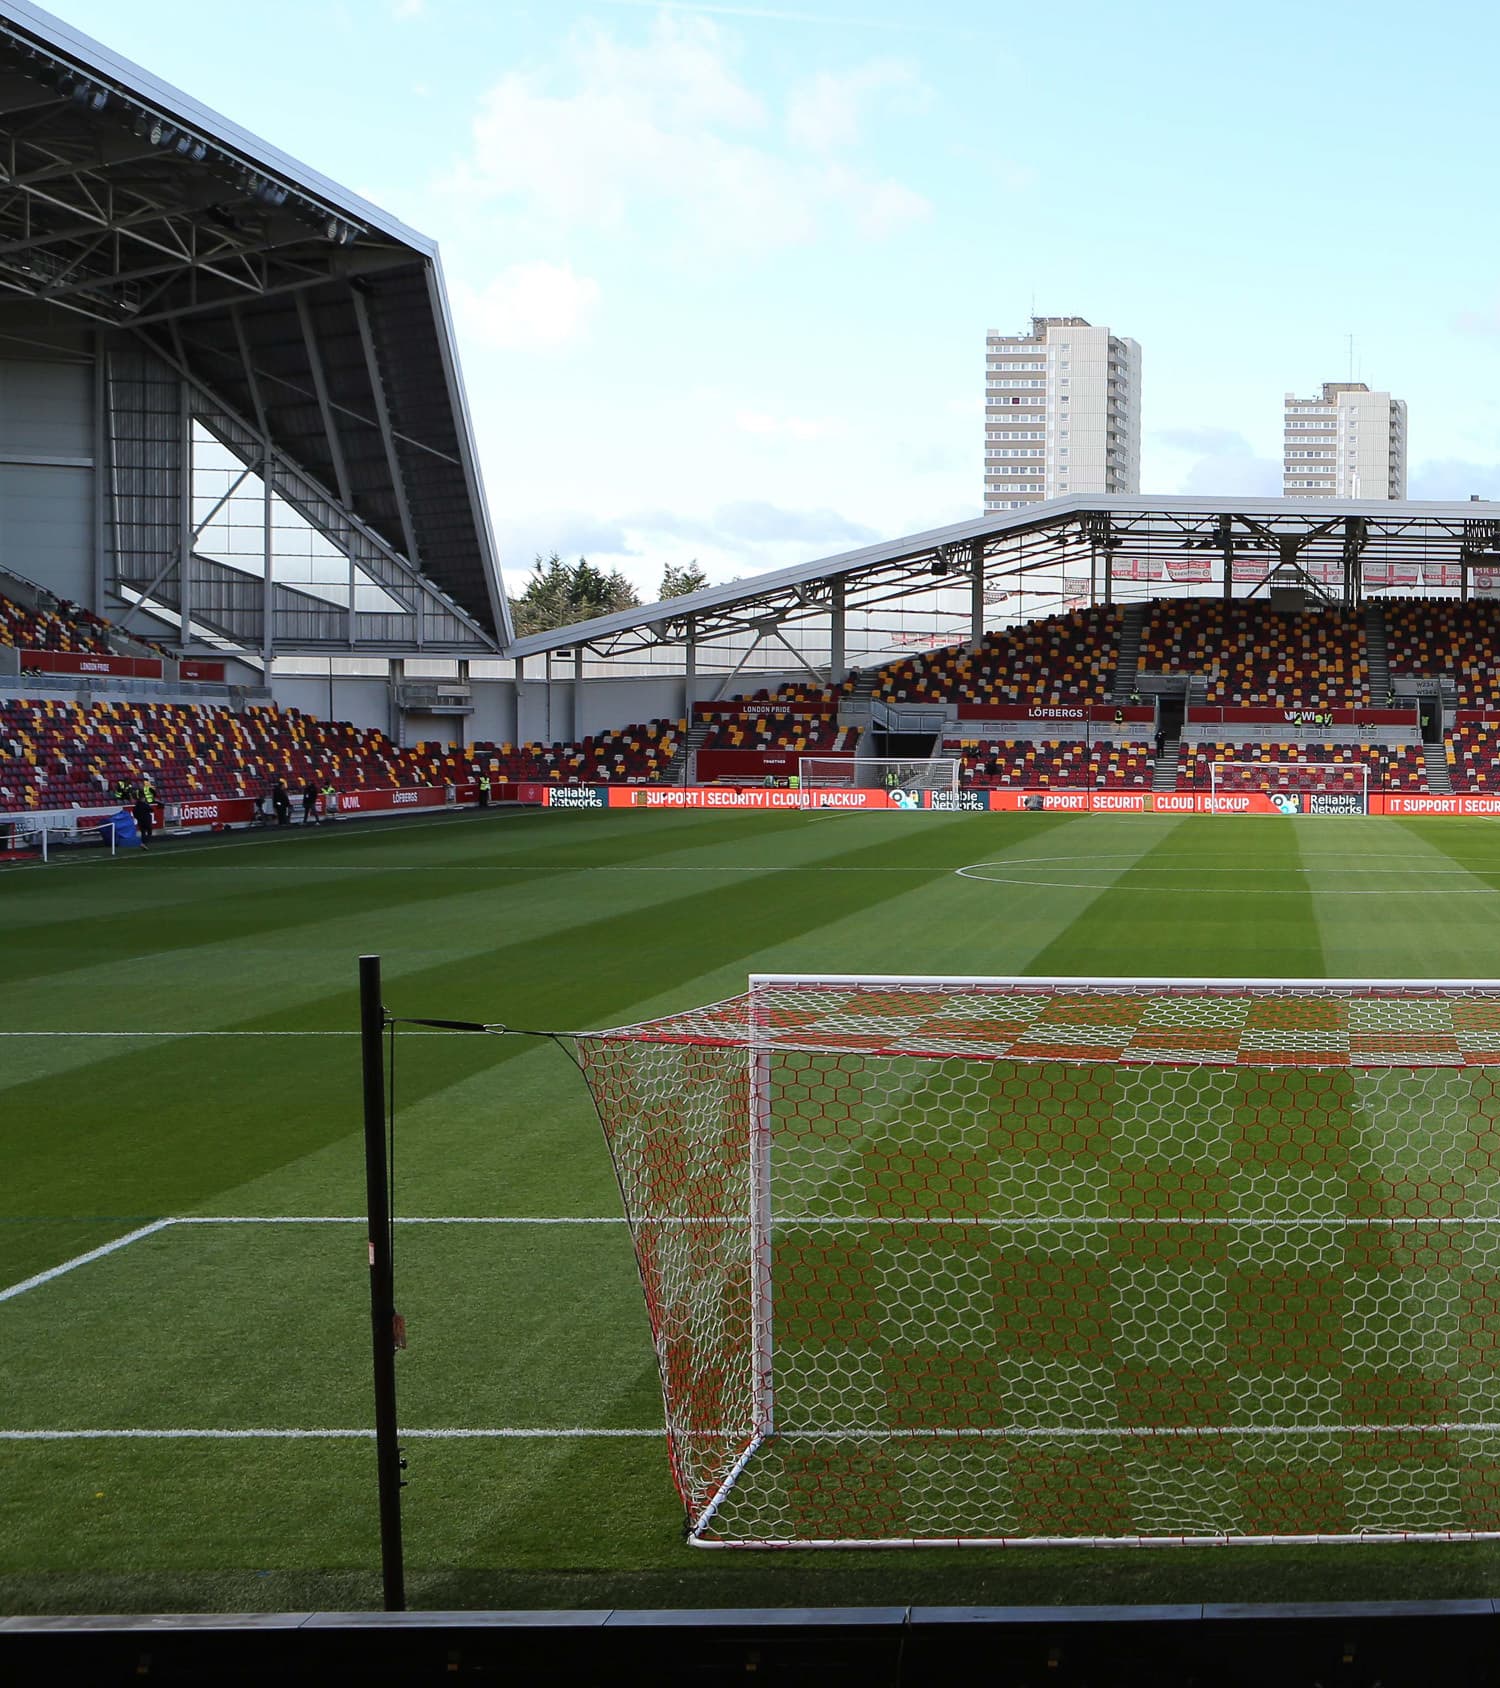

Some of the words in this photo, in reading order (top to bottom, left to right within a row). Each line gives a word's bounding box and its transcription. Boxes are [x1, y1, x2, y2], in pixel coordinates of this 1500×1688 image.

[1028, 707, 1083, 718] LÖFBERGS
[549, 787, 596, 799] Reliable
[647, 792, 699, 805] SUPPORT
[707, 792, 763, 806] SECURITY
[773, 793, 810, 806] CLOUD
[820, 793, 866, 807] BACKUP
[1157, 797, 1194, 809] CLOUD
[1204, 797, 1249, 810] BACKUP
[1310, 795, 1356, 805] Reliable
[1310, 805, 1362, 815] Networks
[1390, 800, 1401, 811] IT
[1403, 800, 1456, 812] SUPPORT
[180, 806, 218, 820] LÖFBERGS
